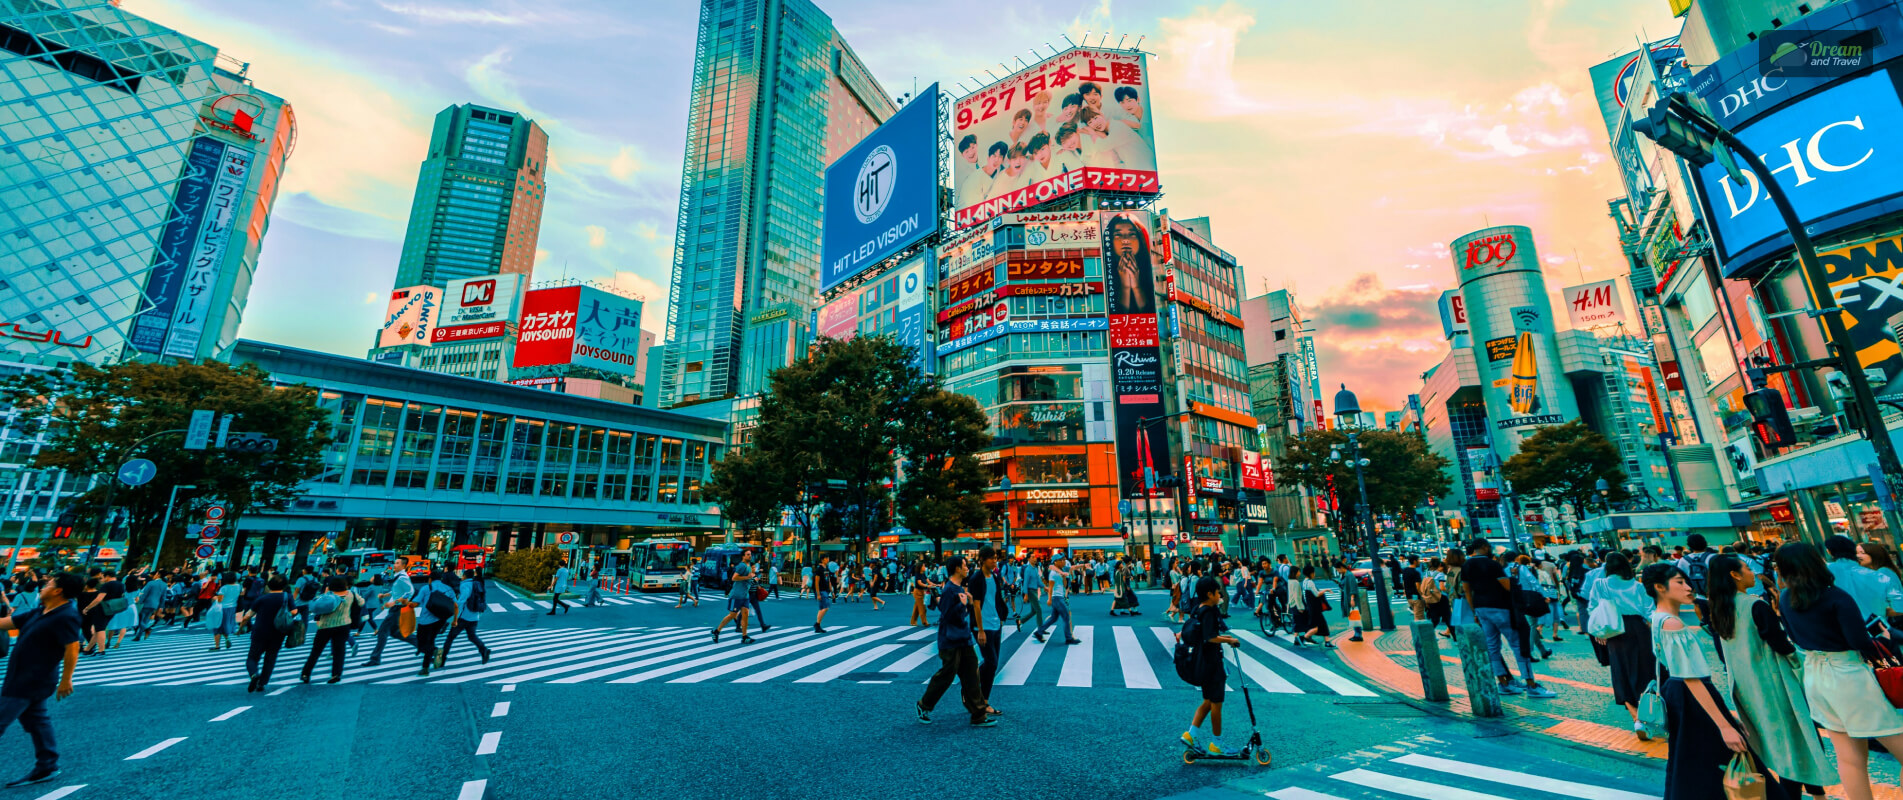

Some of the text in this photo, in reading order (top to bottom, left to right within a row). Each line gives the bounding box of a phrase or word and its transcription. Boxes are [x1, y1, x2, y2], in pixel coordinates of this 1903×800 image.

[957, 59, 1142, 131] 9.27 日本上陸
[1718, 66, 1788, 118] DHC
[1717, 115, 1874, 219] DHC
[1087, 171, 1155, 188] ワナワン
[1050, 226, 1097, 241] しゃぶ葉
[1468, 234, 1513, 248] SHIBUYA
[833, 253, 851, 276] HIT
[853, 239, 875, 265] LED
[877, 212, 919, 250] VISION
[1463, 239, 1517, 270] 109
[1008, 260, 1081, 275] コンタクト
[463, 281, 493, 304] DC
[1060, 283, 1095, 296] ガスト
[1572, 285, 1611, 312] H&M
[974, 291, 998, 310] ガスト
[384, 293, 422, 329] SANKYO
[416, 290, 435, 340] SANKYO
[461, 311, 496, 321] MasterCard
[522, 310, 575, 330] カラオケ
[580, 299, 640, 332] 大声
[1581, 312, 1606, 323] 150m
[964, 312, 992, 336] ガスト
[1013, 319, 1106, 330] AEON 英会話イーオン
[1110, 314, 1157, 328] ユリゴコロ
[519, 328, 574, 343] JOYSOUND
[574, 344, 635, 366] JOYSOUND
[1114, 350, 1157, 367] Rihwa
[1117, 368, 1135, 376] 9.20
[1308, 352, 1318, 381] CAMERA
[1514, 386, 1533, 400] BIG
[1026, 489, 1079, 499] L'OCCITANE
[1246, 503, 1268, 519] LUSH
